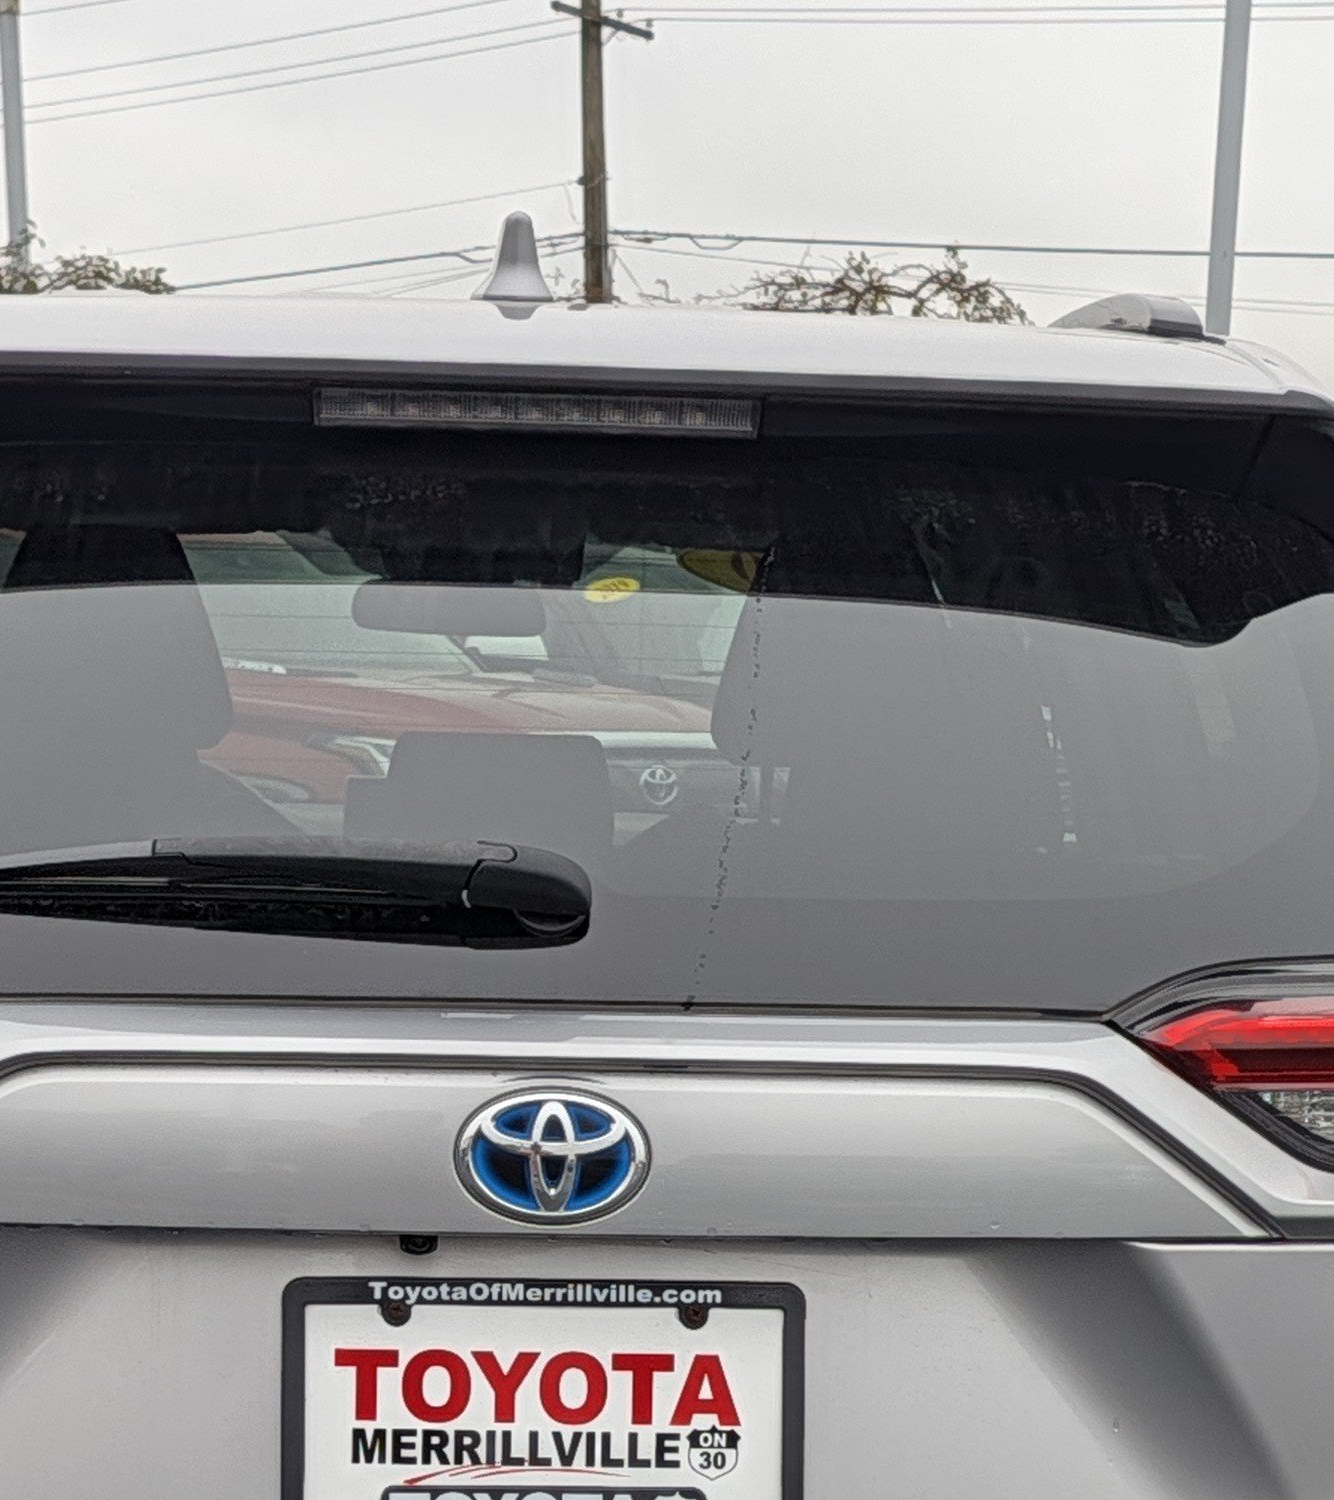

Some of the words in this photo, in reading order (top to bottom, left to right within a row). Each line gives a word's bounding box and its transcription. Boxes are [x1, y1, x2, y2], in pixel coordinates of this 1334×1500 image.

[368, 1281, 723, 1305] ToyotaOfMerrillville.com
[334, 1348, 741, 1427] TOYOTA
[351, 1427, 682, 1469] MERRILLVILLE
[699, 1432, 727, 1449] ON
[698, 1451, 727, 1470] 30
